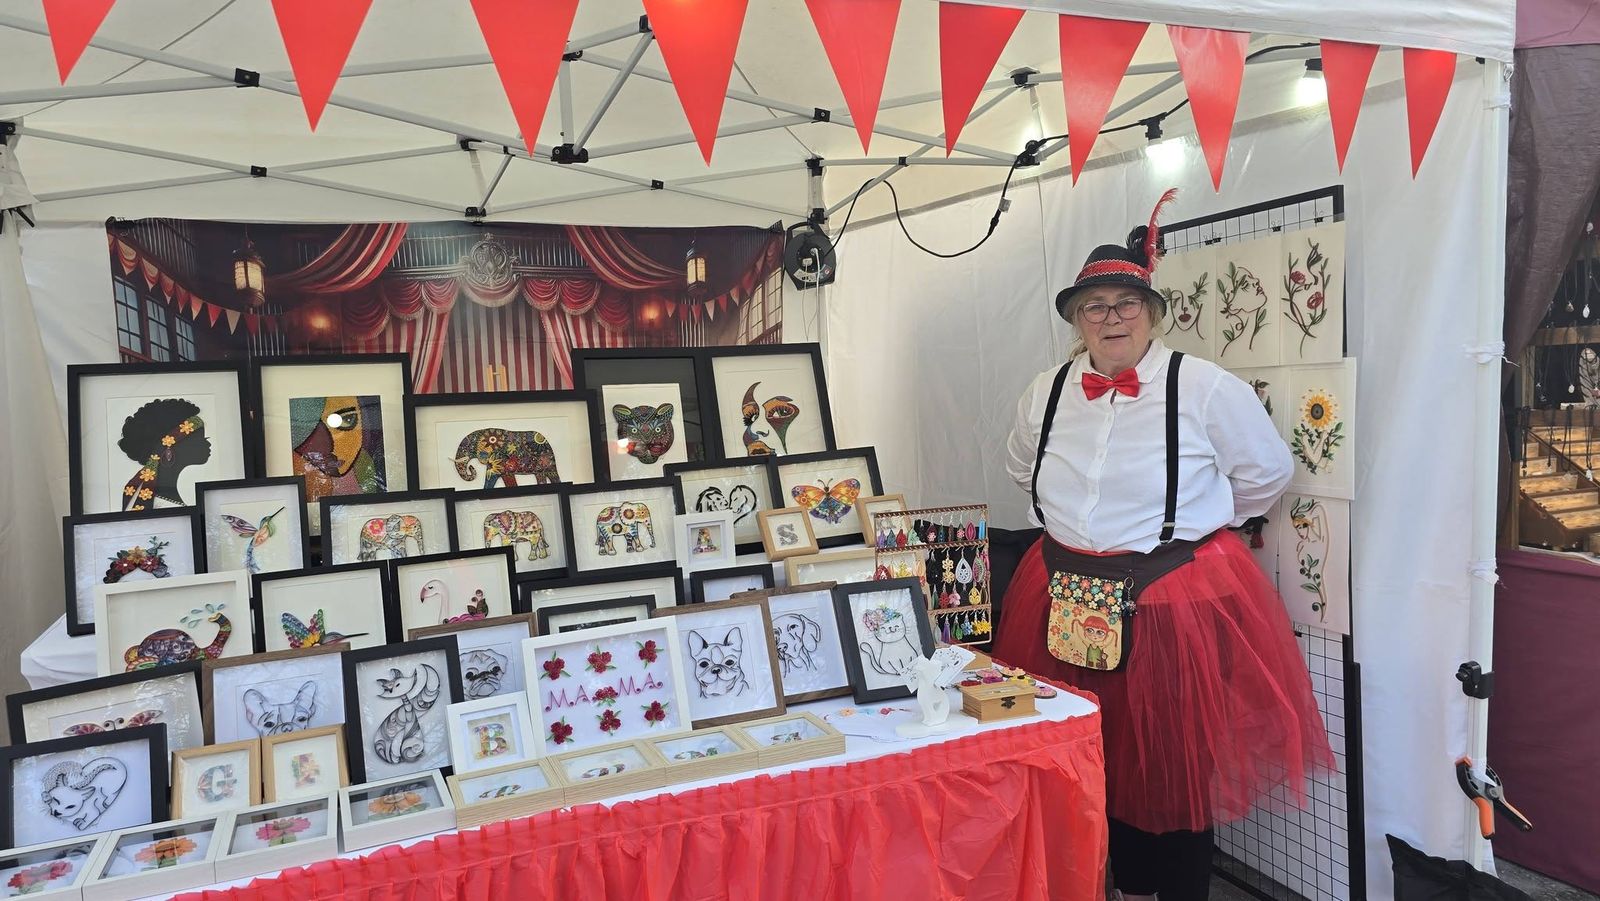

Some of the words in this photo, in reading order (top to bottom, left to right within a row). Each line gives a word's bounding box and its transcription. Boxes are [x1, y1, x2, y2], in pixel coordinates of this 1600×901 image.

[693, 527, 718, 553] A
[777, 523, 799, 546] S
[474, 723, 508, 759] B
[198, 764, 237, 802] G
